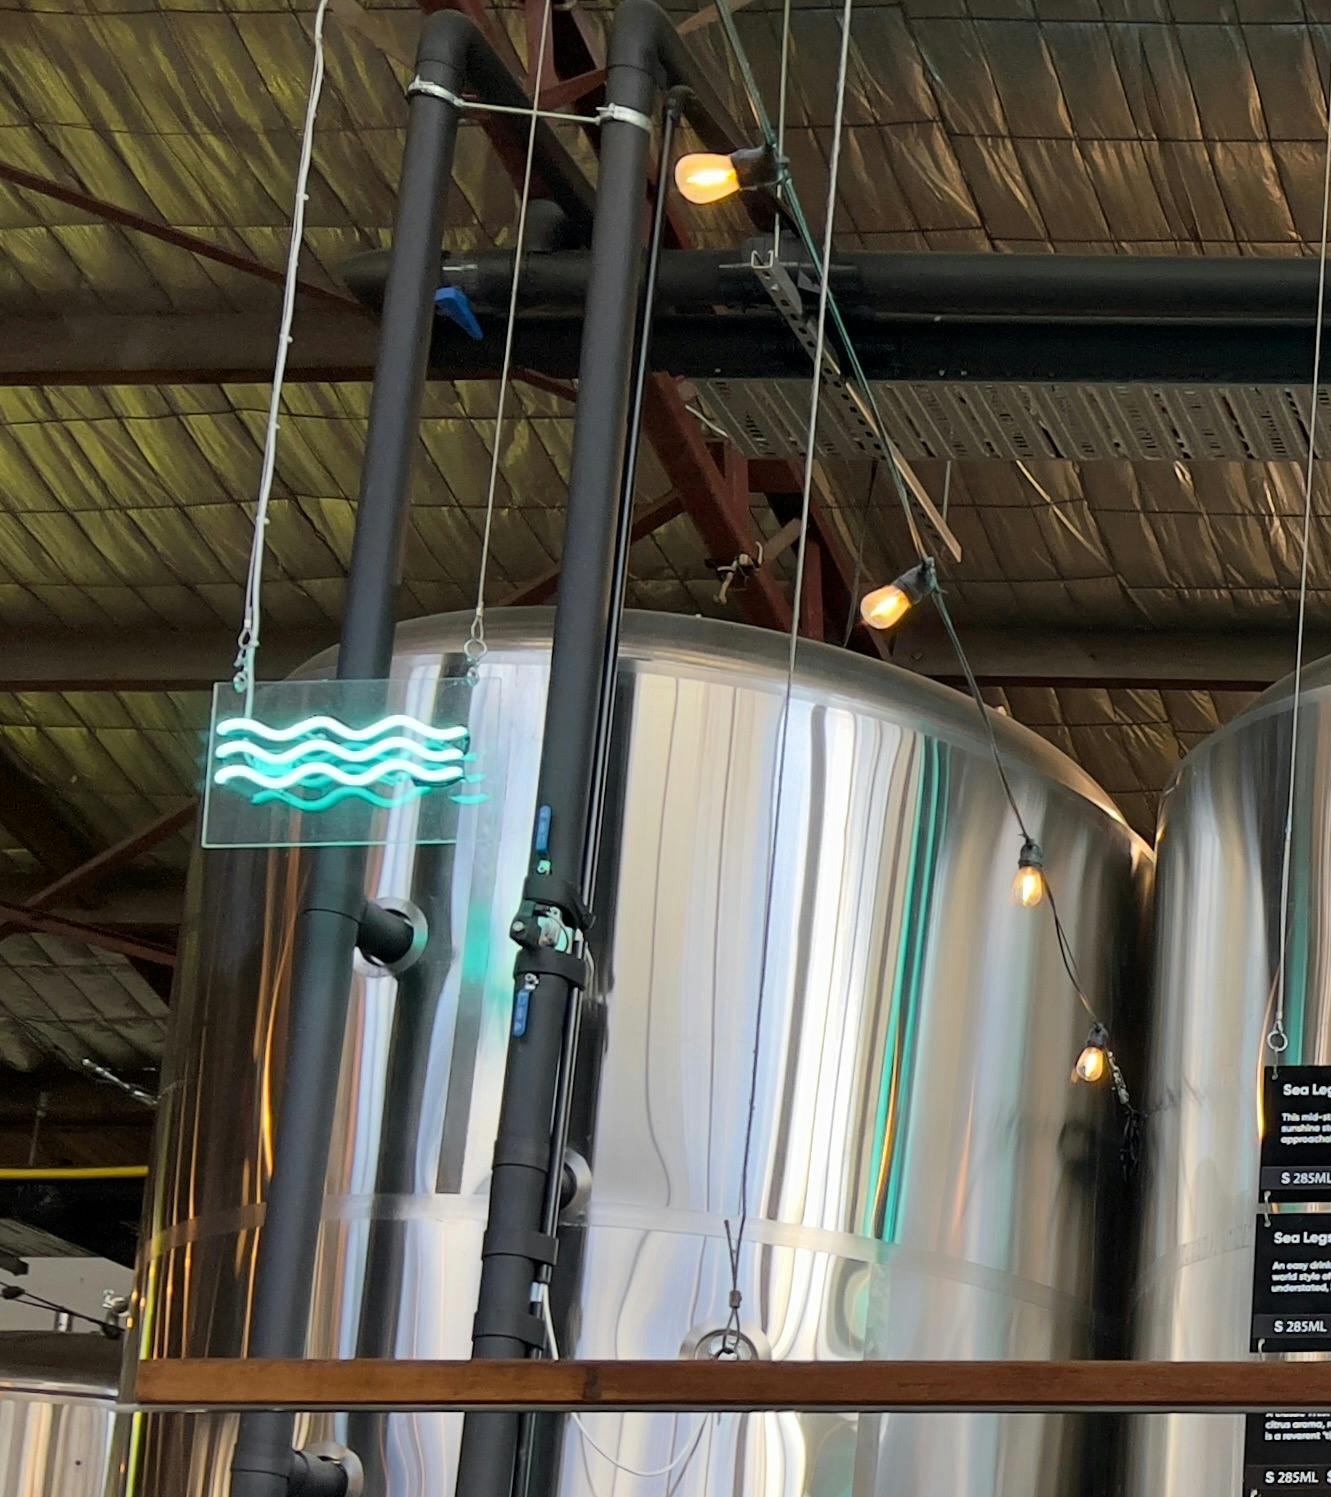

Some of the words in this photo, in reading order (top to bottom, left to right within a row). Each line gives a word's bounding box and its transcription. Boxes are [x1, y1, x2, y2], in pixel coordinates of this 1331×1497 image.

[1284, 1084, 1310, 1095] Sea
[1281, 1173, 1290, 1184] S
[1274, 1232, 1300, 1244] Sea
[1274, 1321, 1283, 1332] S
[1285, 1319, 1327, 1332] 285ML
